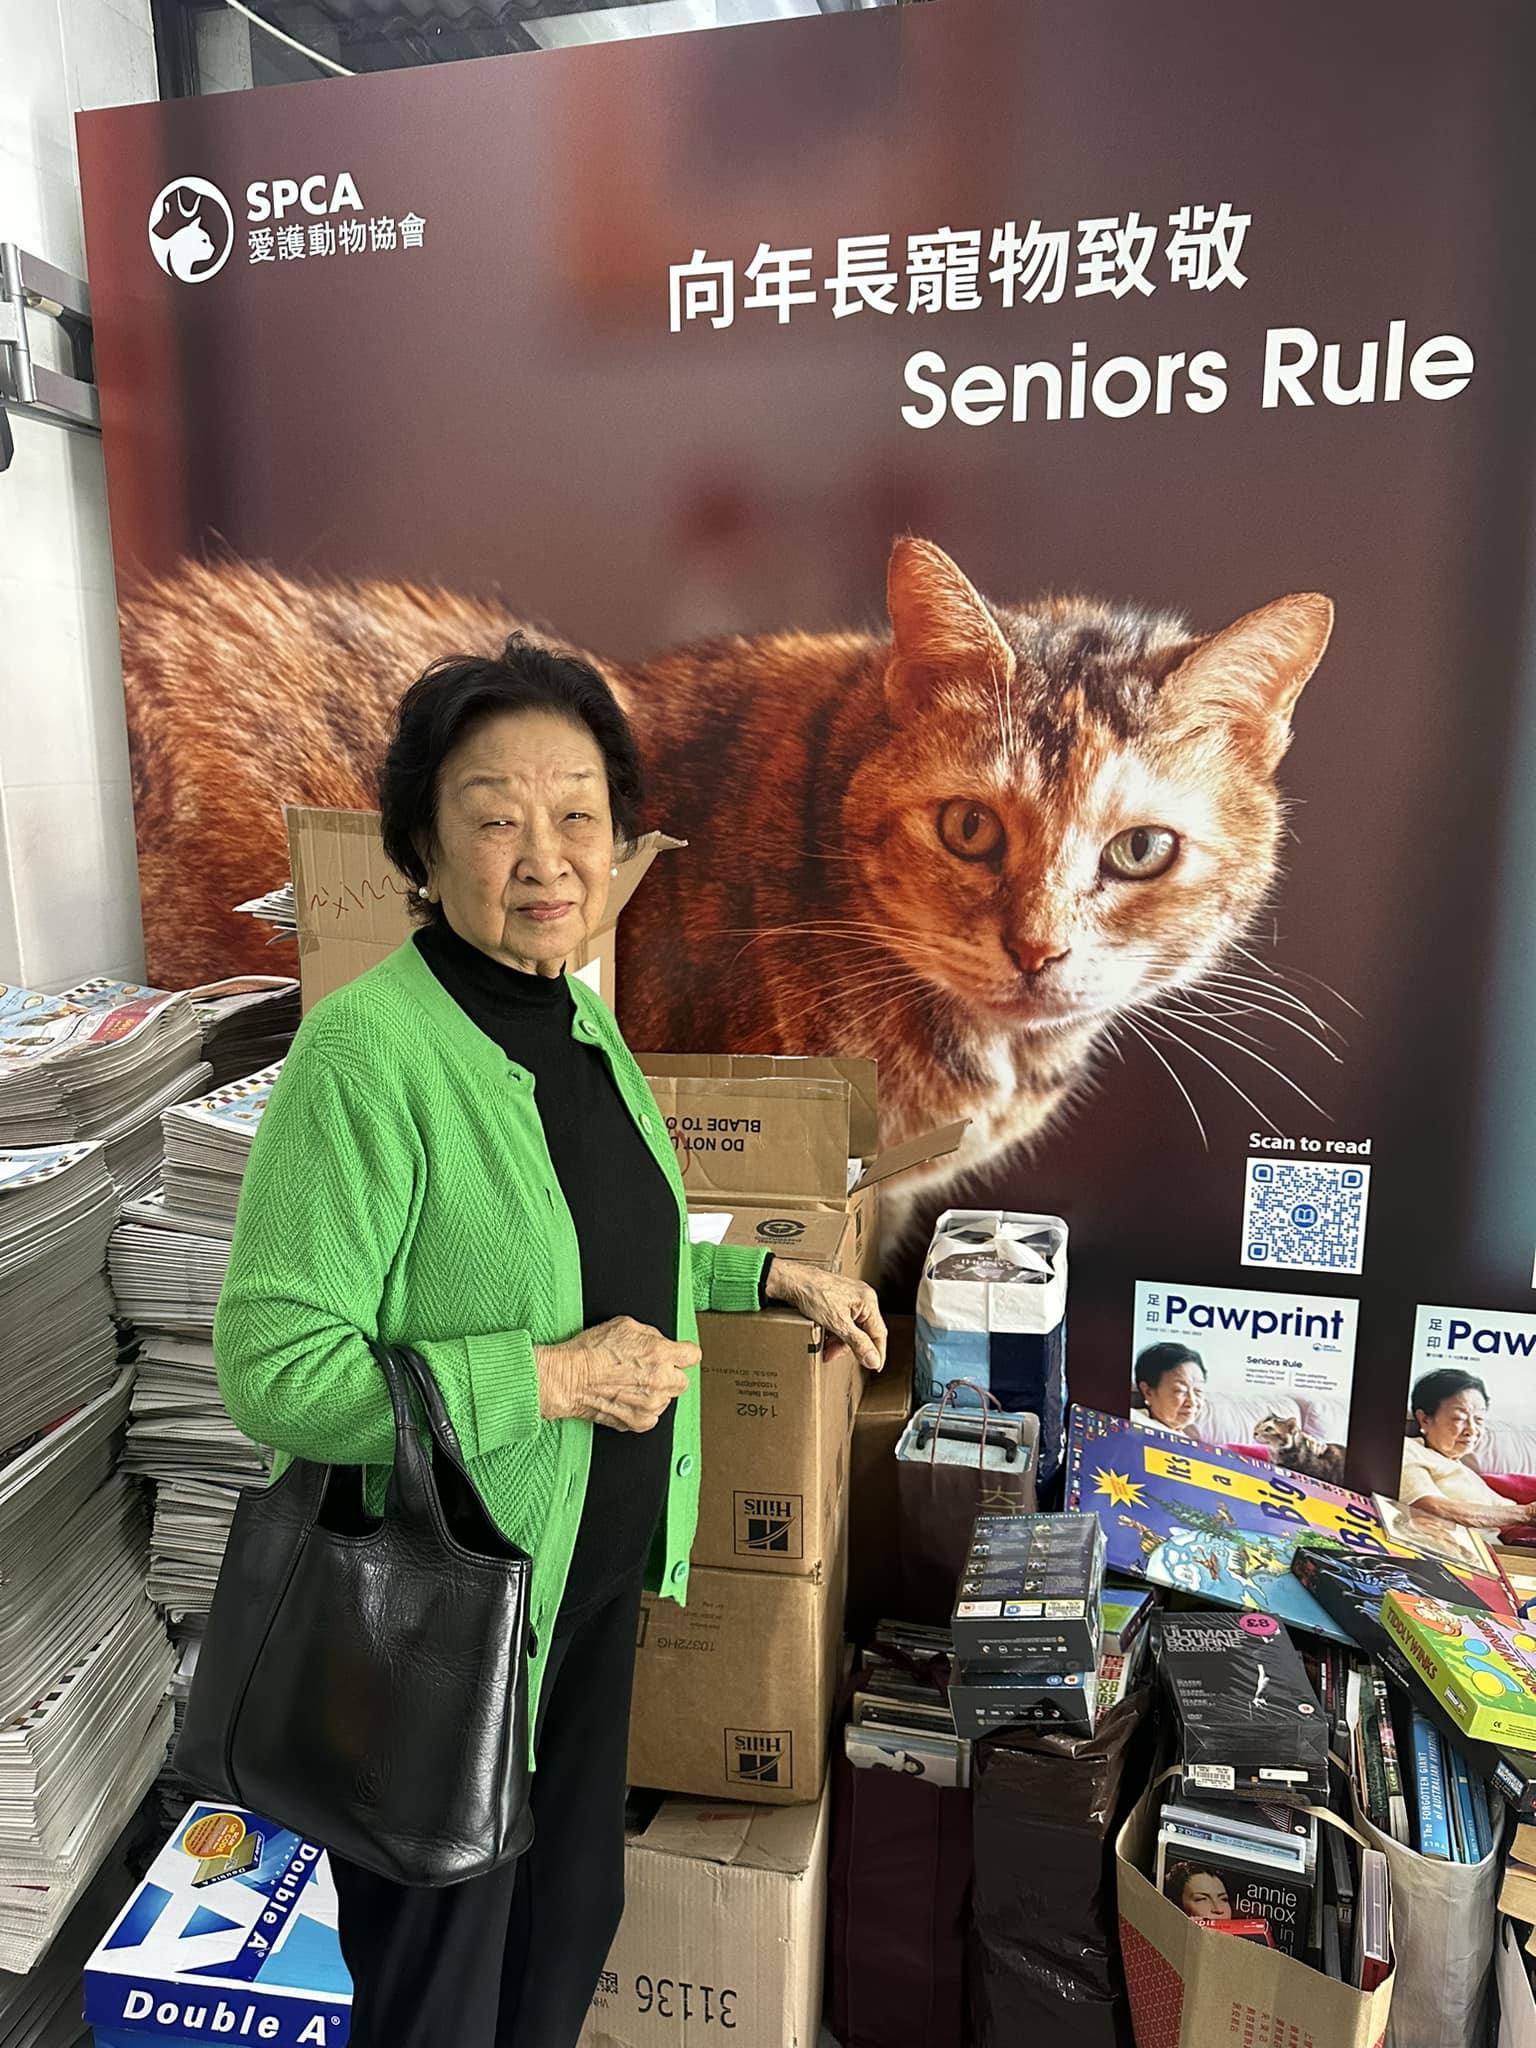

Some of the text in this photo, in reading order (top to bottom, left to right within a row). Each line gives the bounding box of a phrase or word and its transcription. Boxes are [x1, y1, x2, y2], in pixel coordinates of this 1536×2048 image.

[246, 172, 364, 222] SPCA
[247, 211, 427, 264] 愛護動物協會
[668, 203, 1252, 332] 向年長寵物致敬
[900, 319, 1475, 430] Seniors Rule
[682, 1117, 703, 1131] TO
[707, 1118, 761, 1133] BLADE
[684, 1136, 717, 1152] NOT
[721, 1136, 745, 1152] DO
[1248, 1132, 1372, 1156] Scan to read
[1165, 1295, 1345, 1340] Pawprint
[1246, 1355, 1304, 1369] Seniors Rule
[736, 1402, 779, 1419] 1462
[1165, 1455, 1192, 1481] It's
[1212, 1473, 1232, 1487] a
[743, 1498, 792, 1518] Hill's
[1257, 1475, 1311, 1527] Big
[1163, 1628, 1249, 1640] ULTIMATE
[1166, 1637, 1245, 1649] BOURNE
[1167, 1646, 1228, 1654] COLLECTION
[734, 1734, 782, 1754] Hill's
[1417, 1751, 1433, 1838] The FORGOTTEN GIANT
[262, 1842, 320, 1926] Double
[1246, 1882, 1298, 1908] annie
[1234, 1893, 1297, 1925] lennox
[121, 1989, 281, 2040] Double
[635, 1974, 738, 2030] 31136
